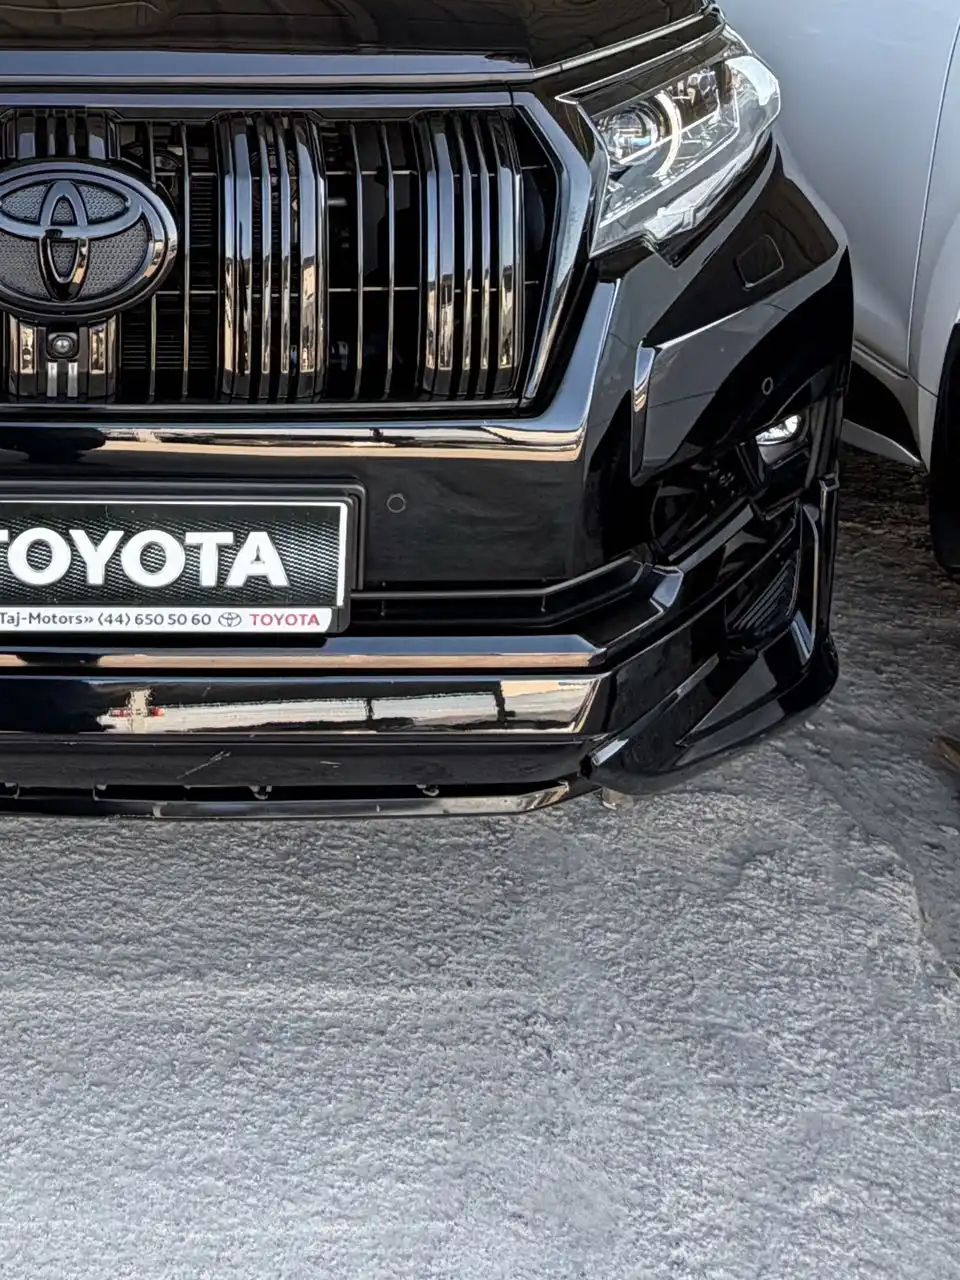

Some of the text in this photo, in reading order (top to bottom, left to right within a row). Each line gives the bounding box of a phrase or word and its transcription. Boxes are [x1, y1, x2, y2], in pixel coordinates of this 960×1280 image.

[134, 613, 164, 626] 650
[167, 613, 188, 626] 50
[191, 613, 212, 626] 60
[248, 613, 320, 626] TOYOTA
